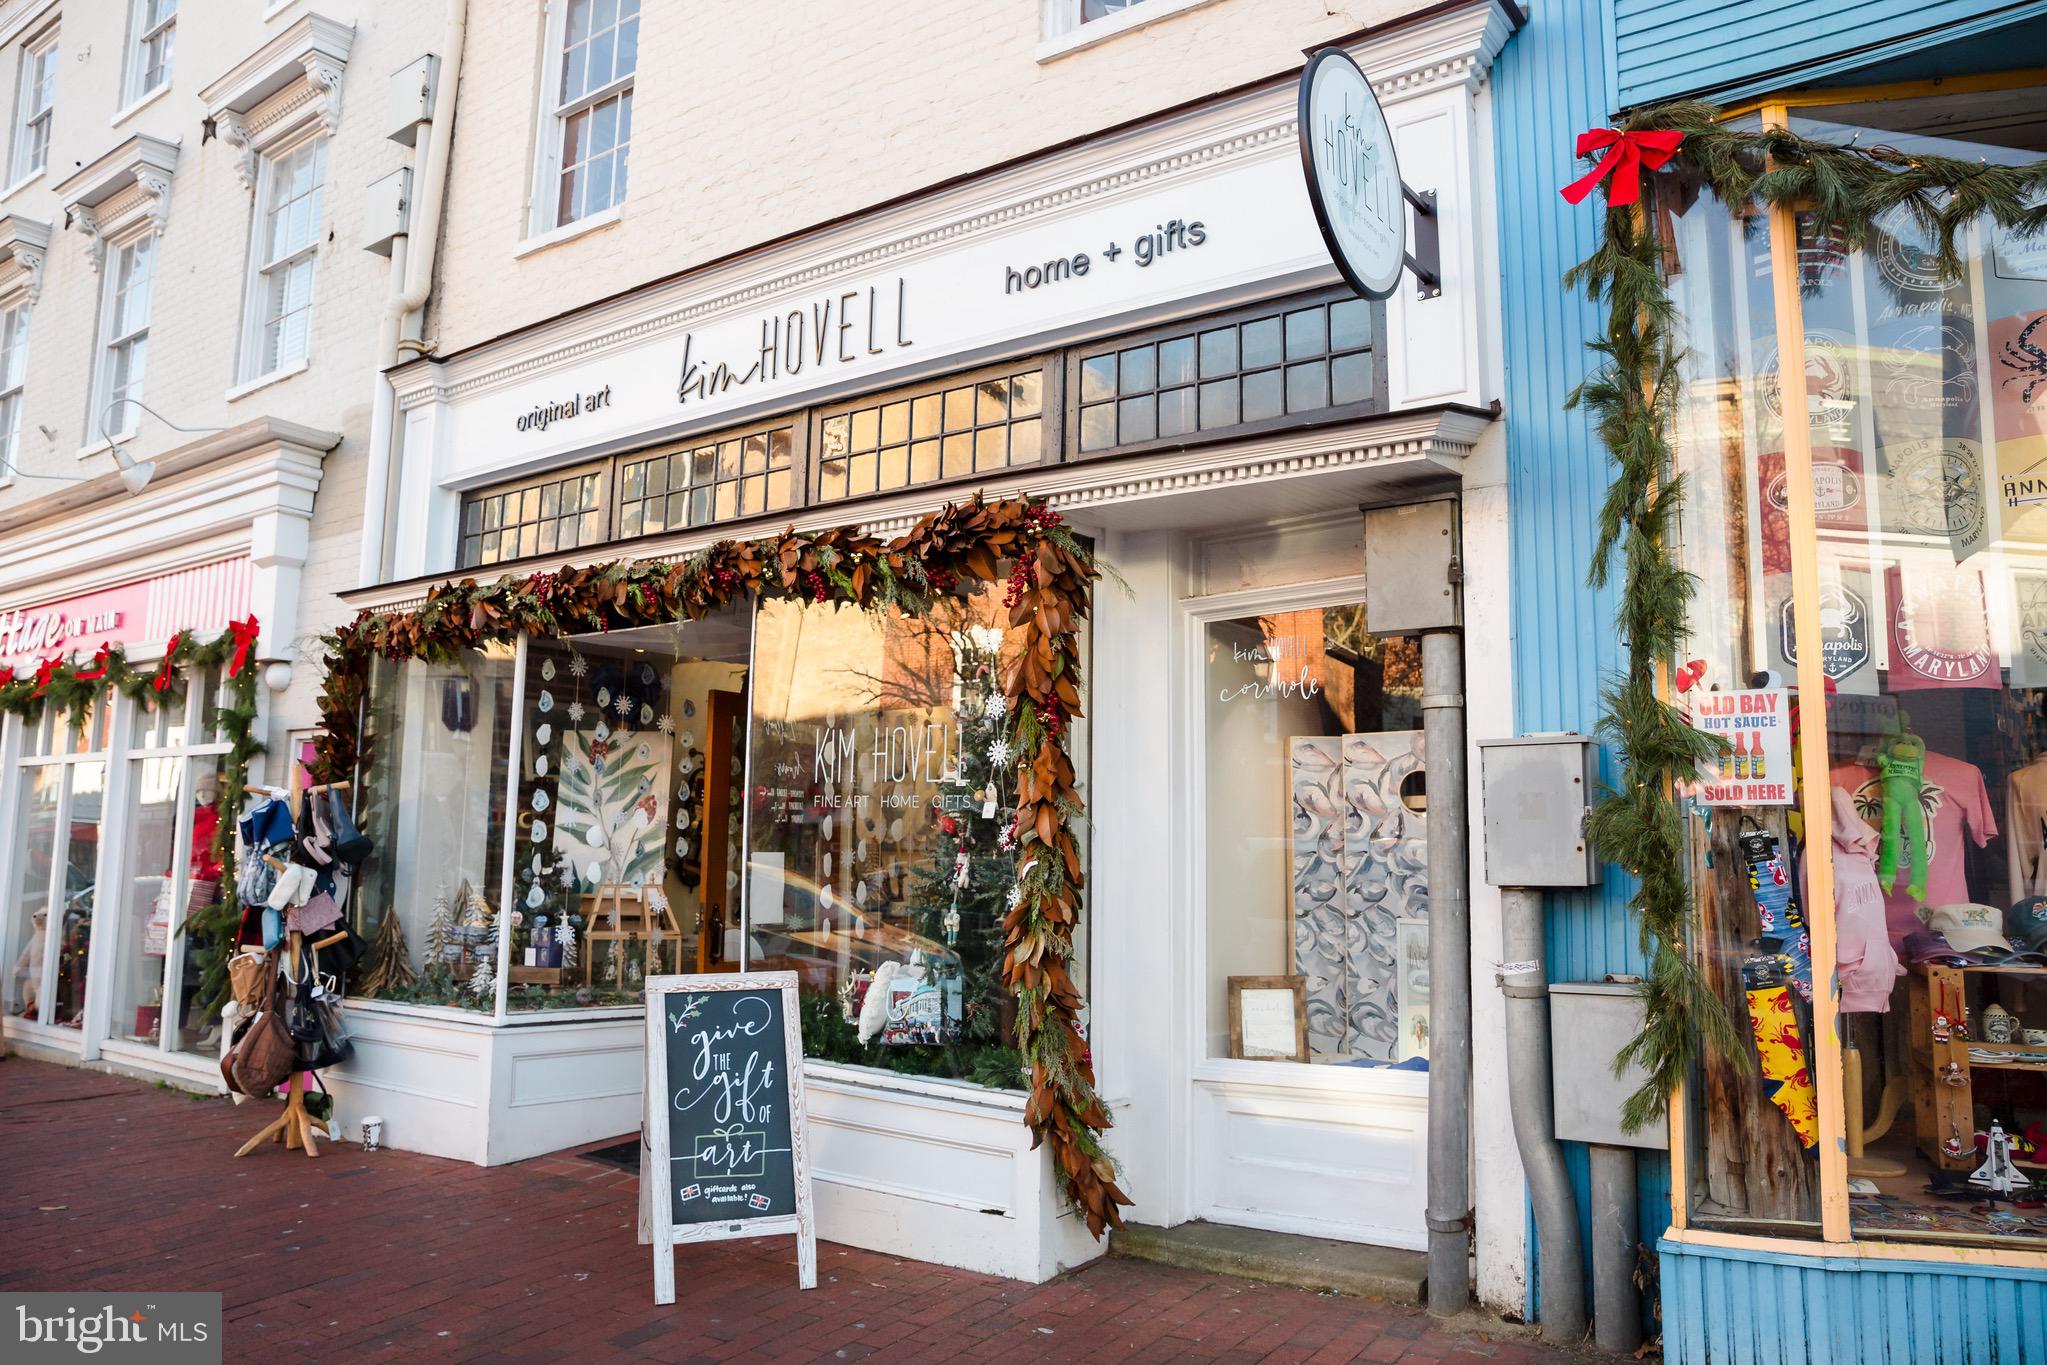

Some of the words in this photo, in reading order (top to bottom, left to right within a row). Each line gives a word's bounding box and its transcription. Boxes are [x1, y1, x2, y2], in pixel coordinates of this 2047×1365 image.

[1324, 113, 1395, 234] HOVELL
[1005, 247, 1090, 294] home
[1103, 241, 1122, 264] +
[1133, 218, 1206, 267] gifts
[677, 332, 762, 404] kim
[759, 277, 914, 382] HOVELL
[516, 393, 581, 432] original
[583, 383, 611, 415] art
[1961, 506, 1985, 548] MARYLAND
[65, 617, 81, 637] ON
[86, 609, 117, 633] MAIN
[1233, 641, 1268, 664] kim
[1904, 641, 1992, 677] MARYLAND
[1220, 665, 1319, 702] cornhole
[1739, 693, 1779, 714] BAY
[1704, 716, 1731, 729] HOT
[1734, 715, 1777, 728] SAUCE
[814, 725, 856, 784] KIM
[871, 722, 971, 784] HOVELL
[814, 796, 842, 808] FINE
[844, 795, 870, 808] ART
[880, 796, 920, 808] HOME
[931, 794, 971, 808] GIFTS
[1704, 785, 1743, 801] SOLD
[1746, 783, 1786, 800] HERE
[691, 997, 772, 1080] give
[713, 1052, 731, 1071] THE
[675, 1051, 774, 1124] gift
[759, 1104, 771, 1123] OF
[699, 1140, 762, 1168] art
[704, 1184, 738, 1199] giftcards
[740, 1183, 757, 1191] also
[711, 1193, 748, 1203] available!
